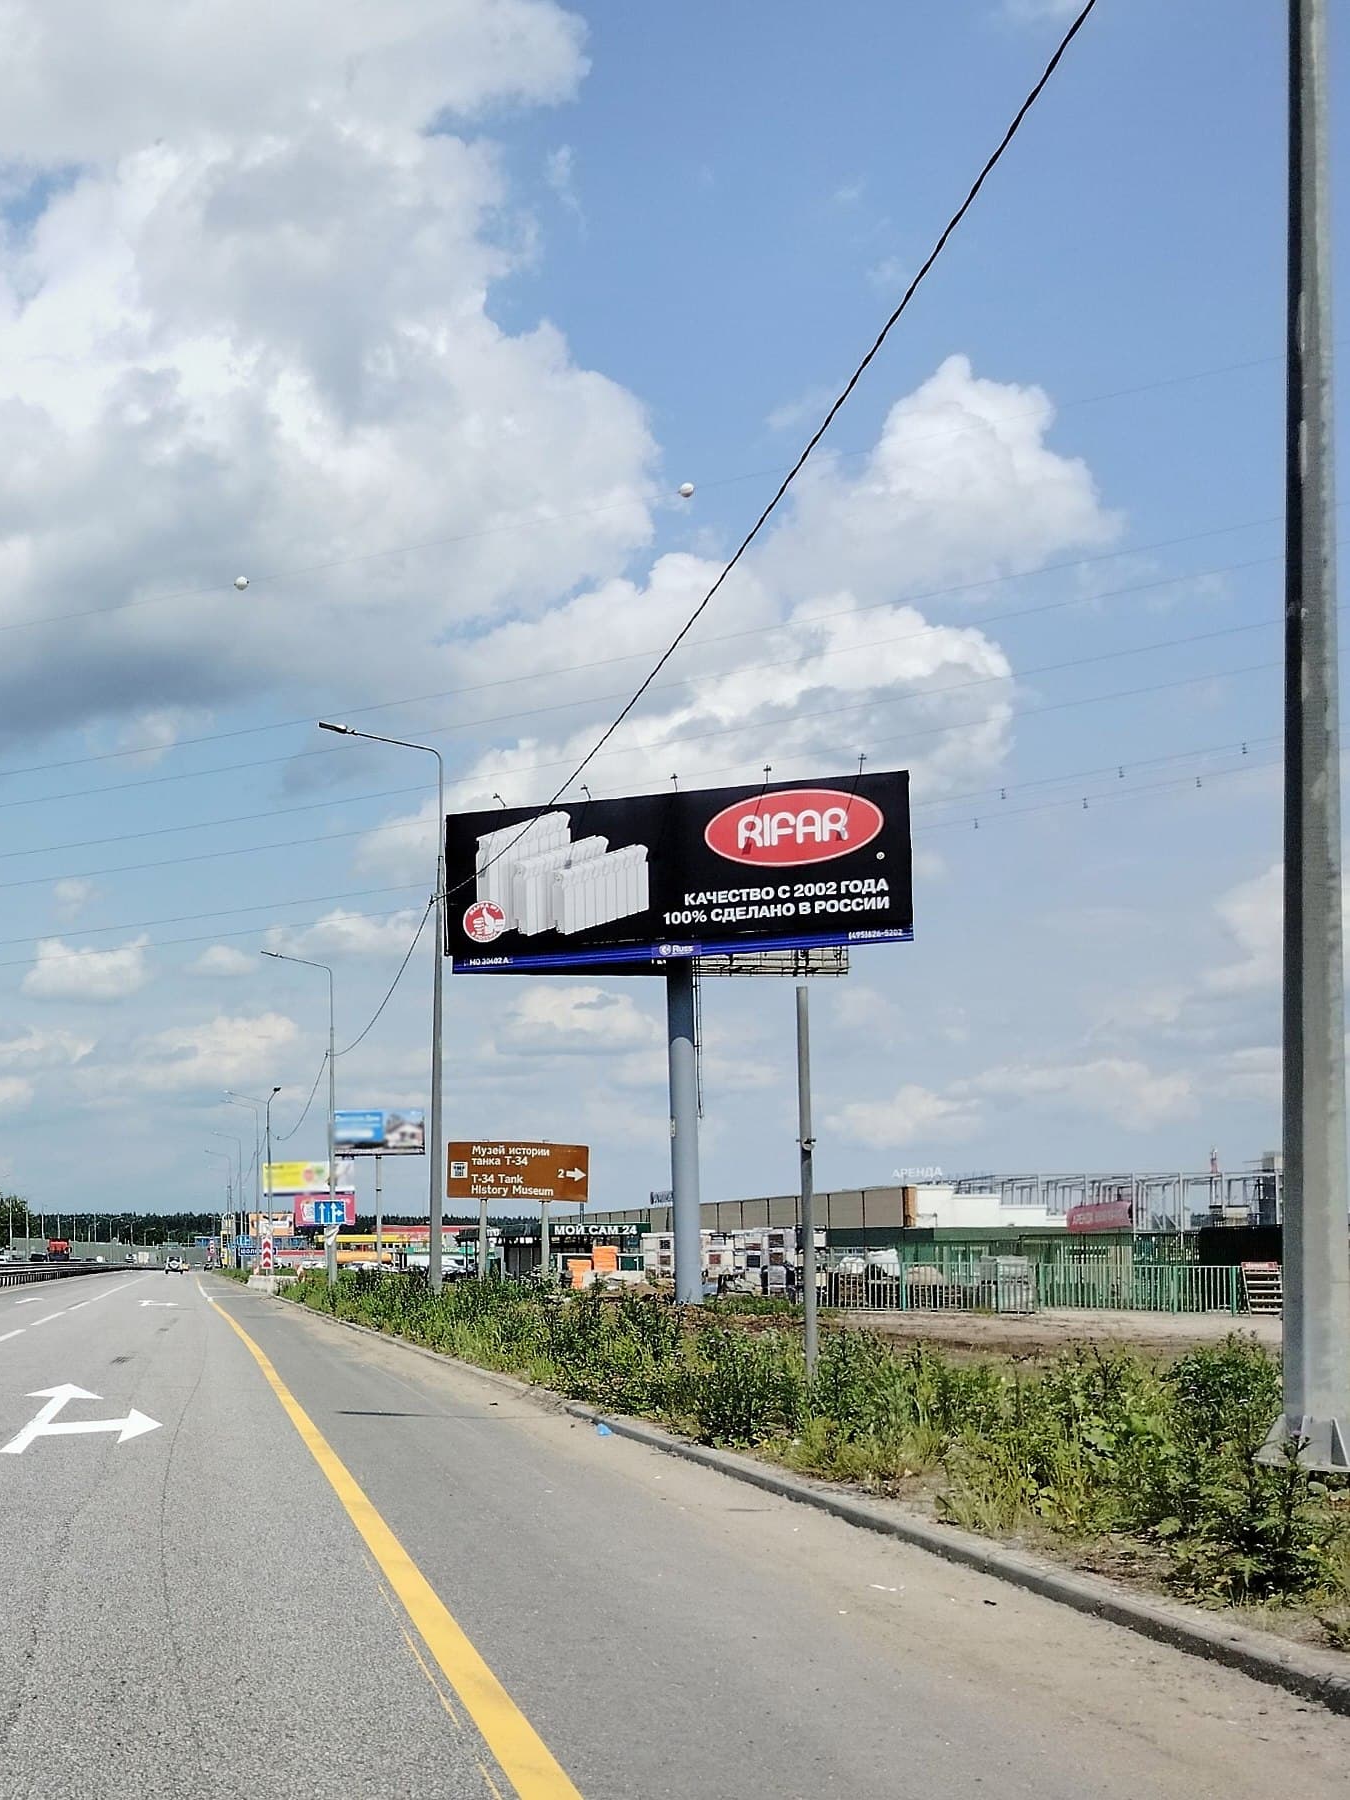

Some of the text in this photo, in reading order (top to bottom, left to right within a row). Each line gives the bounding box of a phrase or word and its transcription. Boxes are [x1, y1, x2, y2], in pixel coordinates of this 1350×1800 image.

[737, 807, 849, 850] RIFAR
[684, 878, 889, 906] КАЧЕСТВО С 2002 ГОДА
[663, 896, 890, 925] 100% СДЕЛАНО В РОССИИ
[472, 1145, 550, 1158] Музей истории
[471, 1156, 528, 1166] танка Т-34
[557, 1169, 565, 1179] 2
[891, 1167, 943, 1178] АРЕНДА
[471, 1174, 524, 1184] T-34 Tank
[471, 1185, 554, 1197] History Museum
[554, 1223, 638, 1236] МОЙ САМ 24
